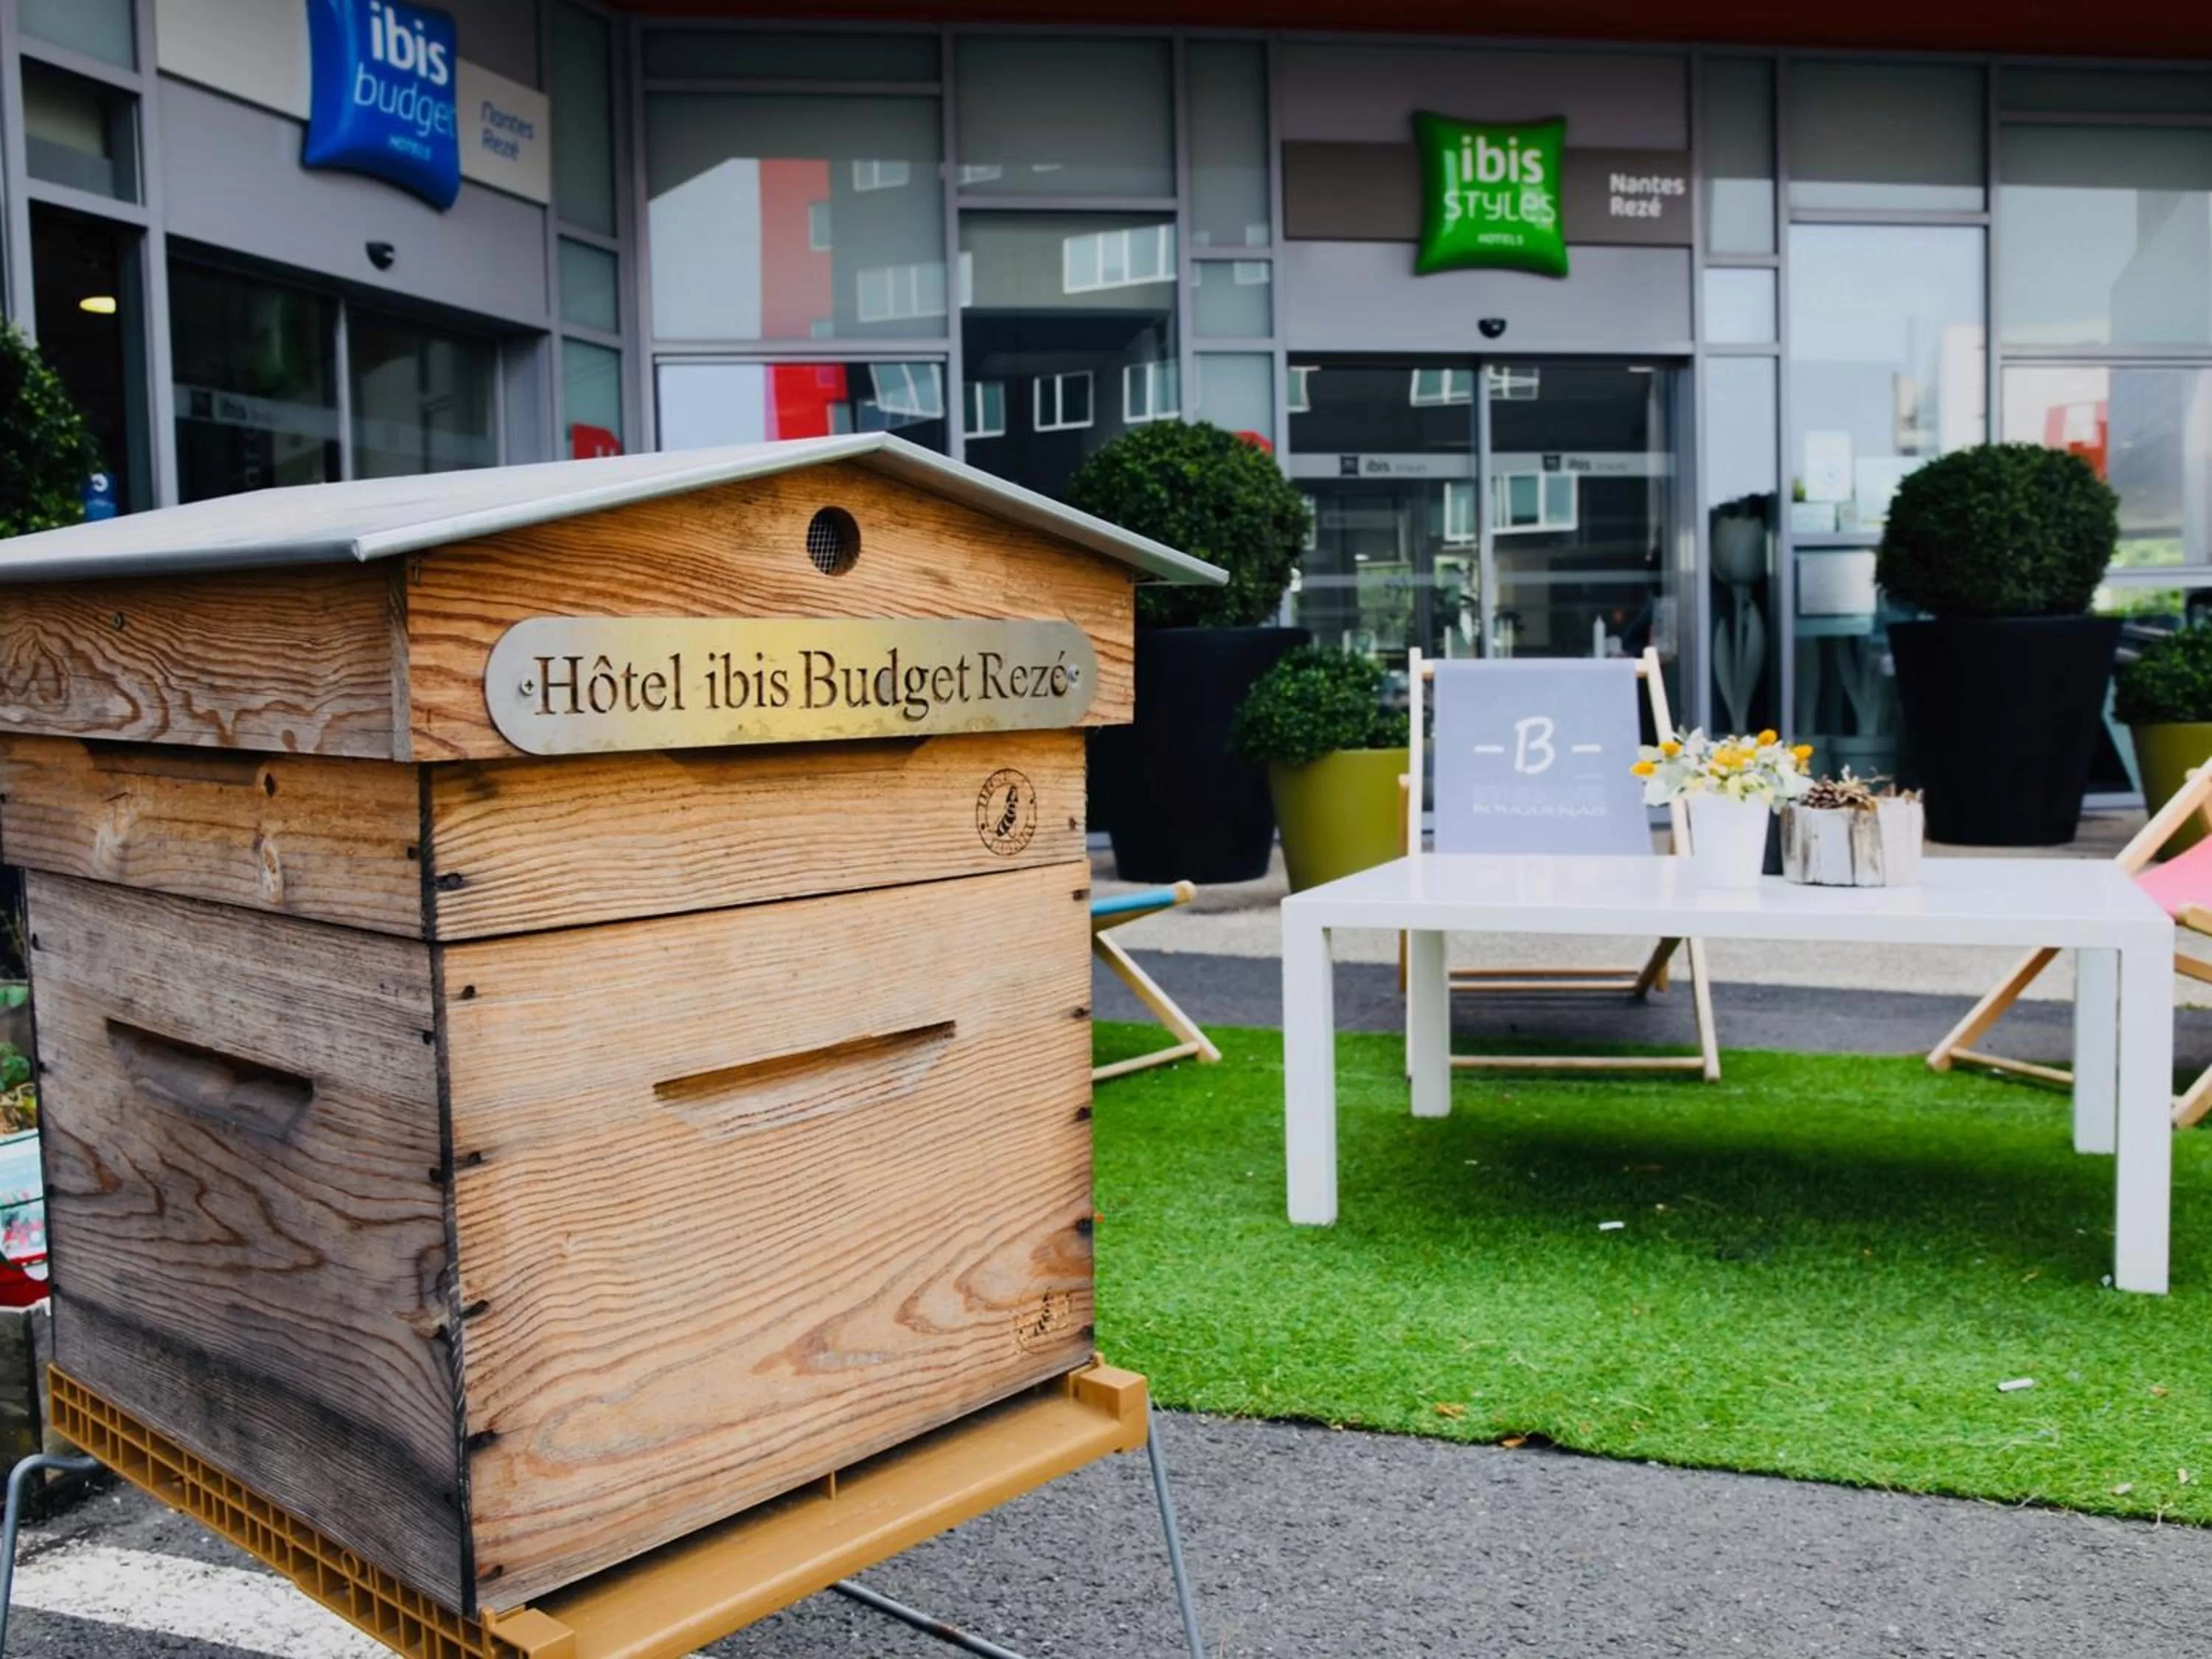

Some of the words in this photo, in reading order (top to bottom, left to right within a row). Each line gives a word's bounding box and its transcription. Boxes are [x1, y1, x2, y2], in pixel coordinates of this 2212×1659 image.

[370, 1, 448, 86] ibis
[1461, 136, 1545, 184] ibis
[1610, 173, 1686, 195] Nantes
[1610, 195, 1662, 218] Rezé
[534, 653, 684, 716] Hôtel
[704, 651, 790, 710] ibis
[799, 647, 972, 721] Budget
[978, 650, 1069, 700] Rezé
